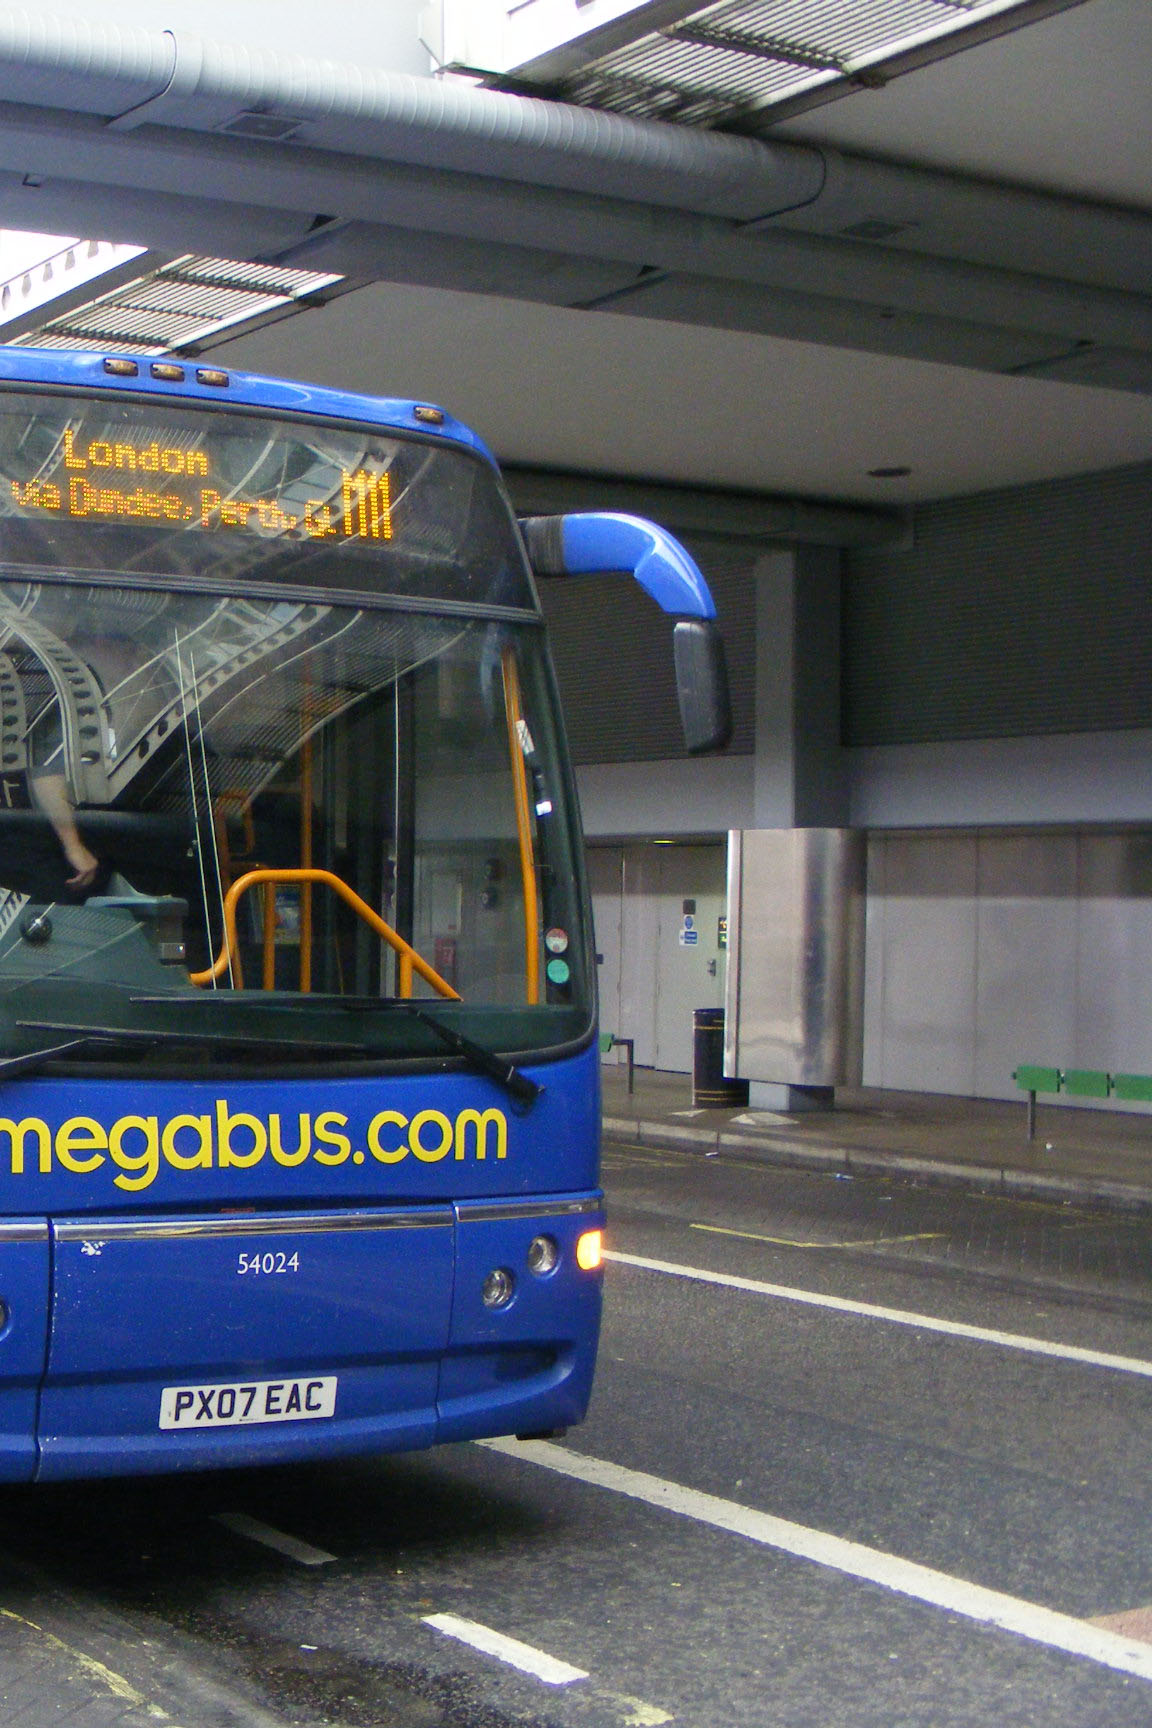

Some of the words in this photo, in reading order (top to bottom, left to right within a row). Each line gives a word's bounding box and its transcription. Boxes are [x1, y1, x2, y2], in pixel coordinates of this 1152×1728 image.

[65, 430, 208, 476] London
[11, 478, 61, 509] via
[237, 1251, 300, 1275] 54024
[174, 1386, 257, 1422] PX07
[264, 1381, 324, 1416] EAC
